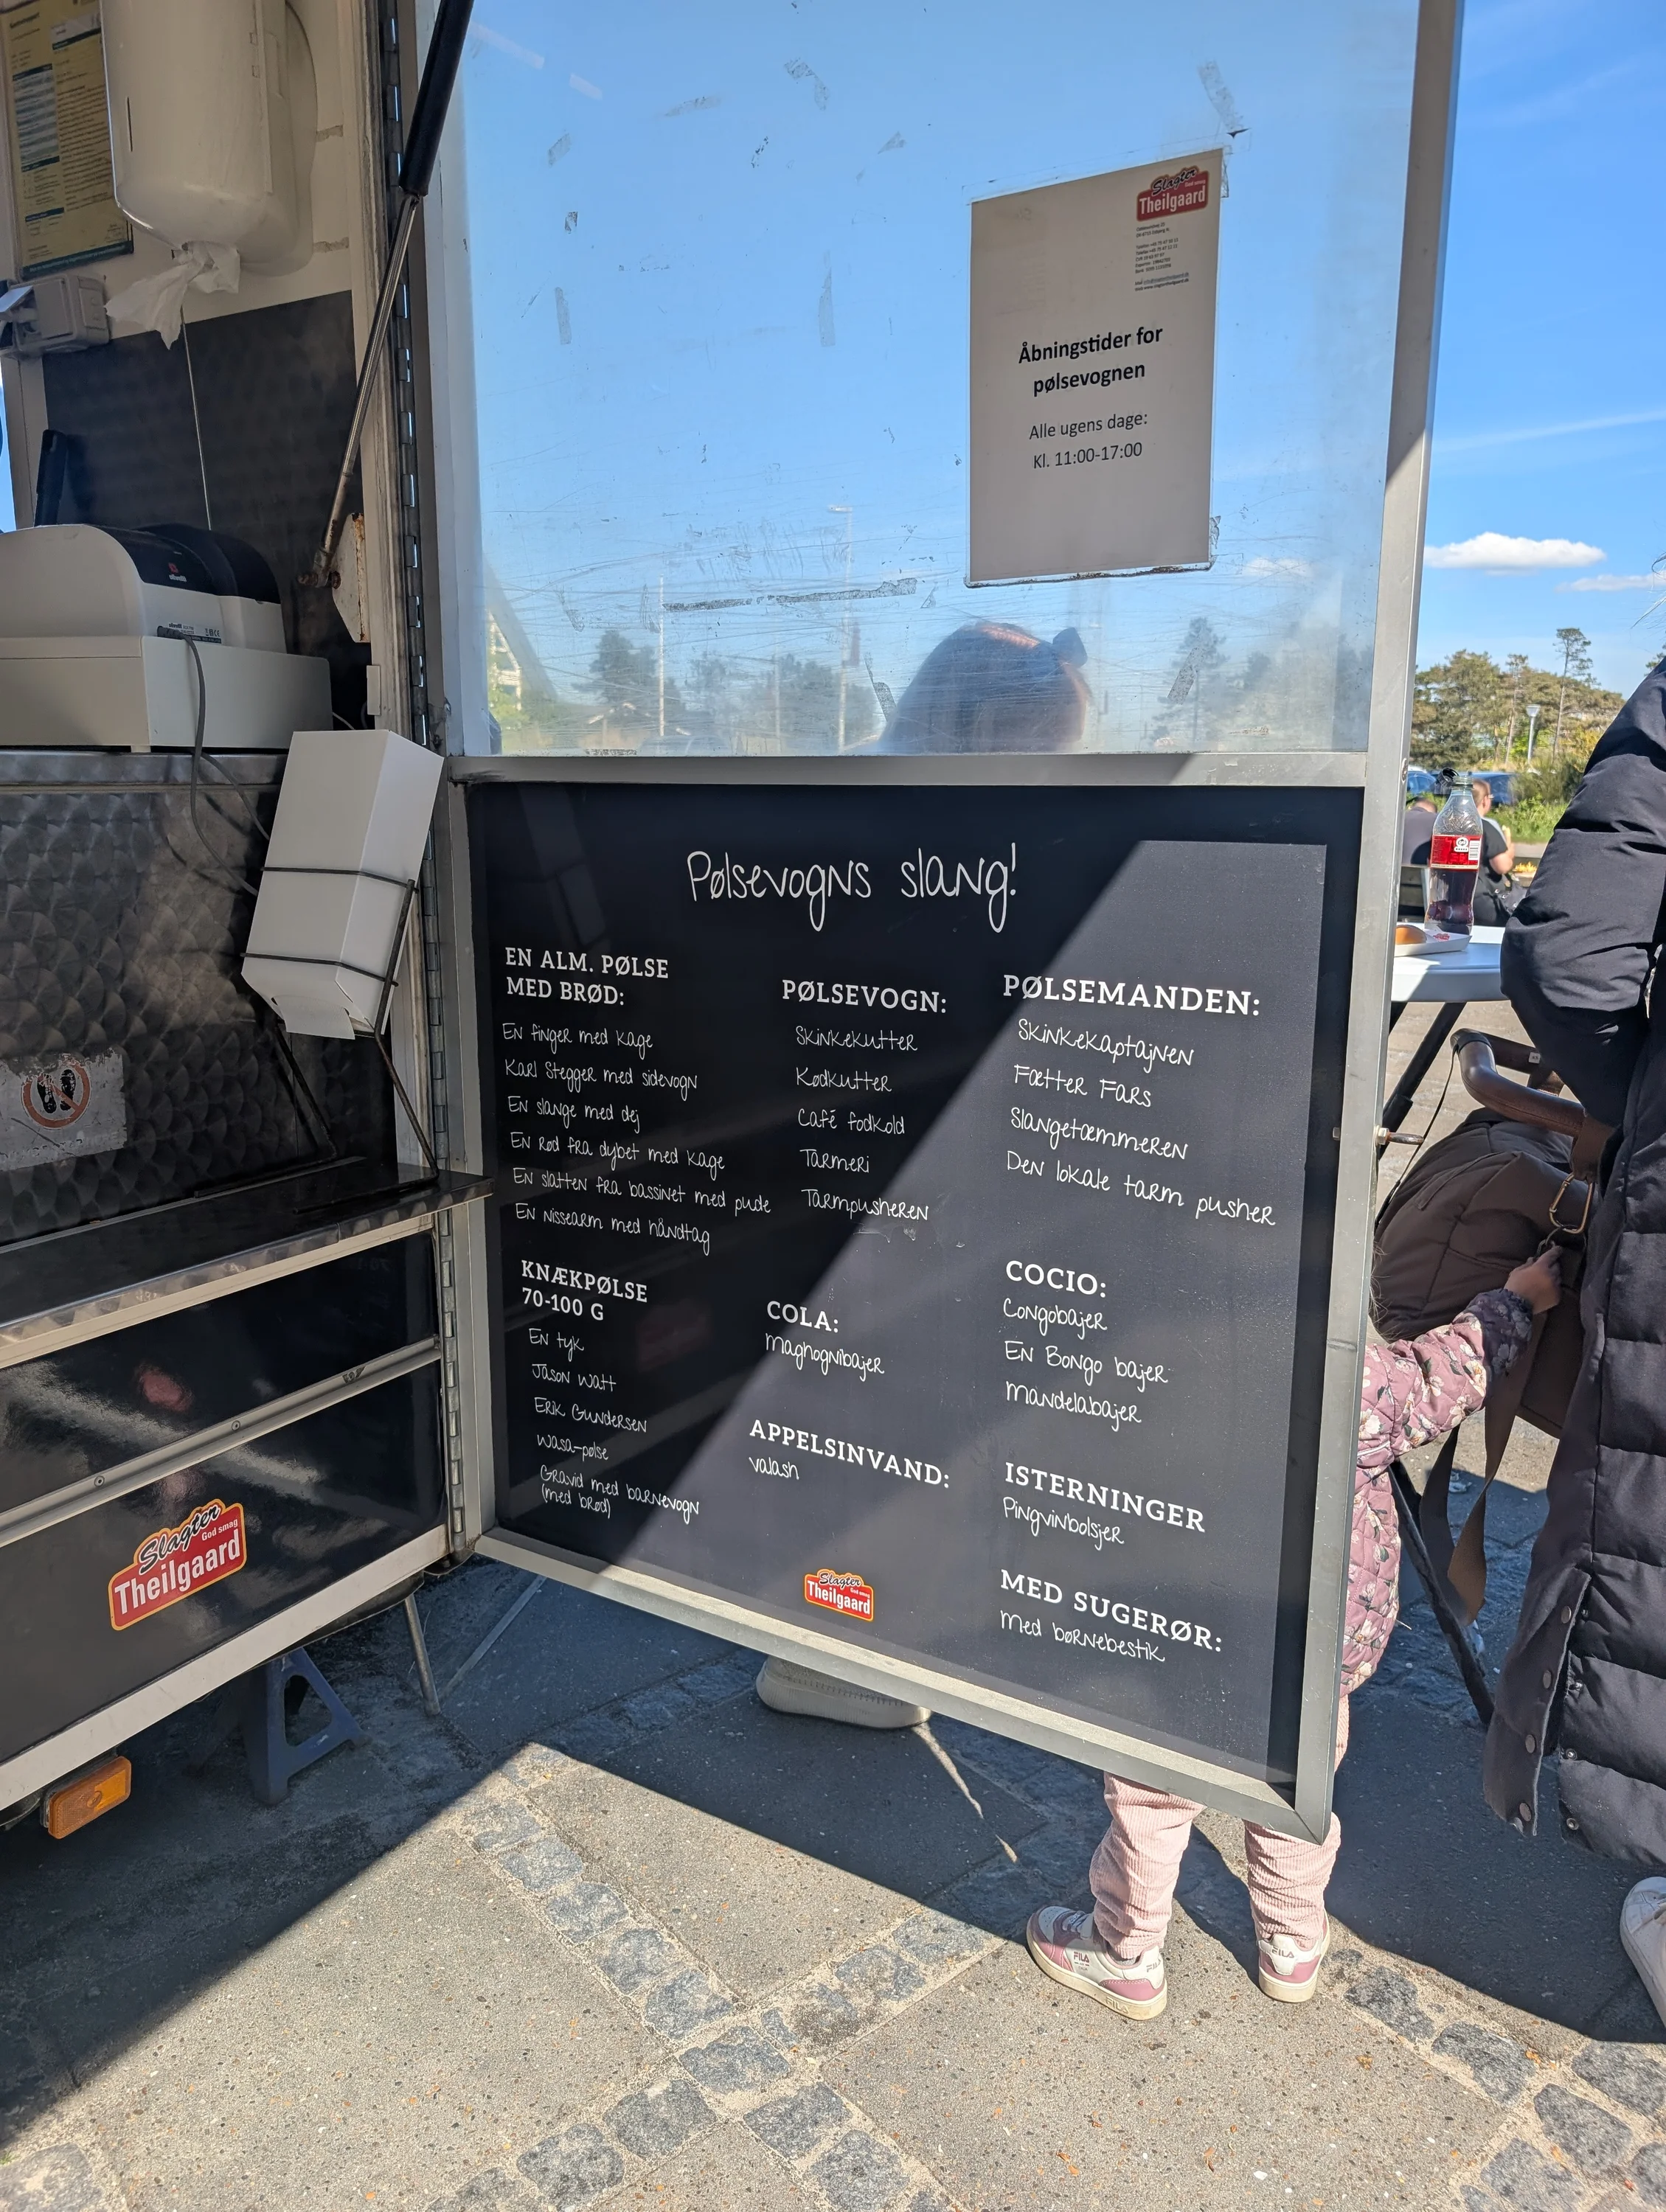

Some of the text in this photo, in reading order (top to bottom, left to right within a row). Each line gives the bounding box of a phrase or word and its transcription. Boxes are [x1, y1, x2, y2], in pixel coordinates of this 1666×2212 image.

[1139, 185, 1206, 215] Theilgaard
[1153, 169, 1195, 195] Slagter
[1018, 327, 1163, 364] Åbningstider for
[1034, 364, 1145, 397] pølsevognen
[1030, 414, 1148, 439] Alle ugens dage:
[1034, 442, 1142, 469] Kl. 11:00-17:00
[687, 842, 1016, 933] Pølsevogns slang!
[505, 947, 668, 978] EN ALM. PØLSE
[507, 977, 625, 1005] MED BRØD:
[782, 980, 948, 1013] PØLSEVOGN:
[1004, 975, 1259, 1015] PØLSEMANDEN:
[502, 1023, 524, 1041] En
[531, 1023, 572, 1054] finger
[580, 1028, 608, 1045] med
[796, 1026, 917, 1051] Skinkekutter
[1018, 1019, 1194, 1073] Skinkekaptajnen
[505, 1059, 697, 1101] Karl Stegger med sidevogn
[796, 1068, 892, 1091] Kødkutter
[1014, 1064, 1150, 1107] Fætter Fars
[508, 1096, 639, 1133] En slange med dej
[799, 1109, 904, 1134] Café fodkold
[1011, 1107, 1188, 1159] Slangetæmmeren
[510, 1132, 530, 1148] En
[568, 1137, 593, 1155] fra
[600, 1141, 639, 1171] dybet
[648, 1147, 680, 1166] med
[802, 1150, 869, 1172] Tarmeri
[513, 1168, 532, 1184] En
[596, 1176, 622, 1195] fra
[629, 1180, 686, 1202] bassinet
[695, 1188, 726, 1207] med
[735, 1192, 771, 1216] pude
[804, 1189, 929, 1220] Tarmpusheren
[1007, 1151, 1275, 1225] Den lokale tarm pusher
[516, 1203, 709, 1256] En nissearm med håndtag
[521, 1260, 649, 1304] KNÆKPØLSE
[1007, 1261, 1108, 1298] COCIO:
[523, 1287, 603, 1321] 70-100 G
[767, 1299, 840, 1335] COLA:
[1004, 1298, 1107, 1340] Congobajer
[529, 1328, 584, 1362] En tyk
[532, 1364, 572, 1383] Jason
[1004, 1340, 1168, 1392] En Bongo bajer
[535, 1397, 647, 1434] Erik Gundersen
[749, 1419, 951, 1488] APPELSINVAND:
[541, 1465, 699, 1524] Gravid med barnevogn
[542, 1486, 610, 1519] (med brød)
[1003, 1462, 1207, 1533] ISTERNINGER
[140, 1506, 220, 1575] Slagter
[202, 1519, 238, 1541] God smag
[1003, 1495, 1125, 1551] Pingvinbolsjer
[114, 1528, 240, 1615] Theilgaard
[819, 1573, 861, 1588] Slagter
[808, 1580, 870, 1615] Theilgaard
[1001, 1569, 1221, 1652] MED SUGERØR:
[1052, 1621, 1166, 1661] børnebestik
[1074, 1951, 1089, 1963] FILA
[1271, 1946, 1295, 1958] FILA
[1106, 1995, 1130, 2014] FILA
